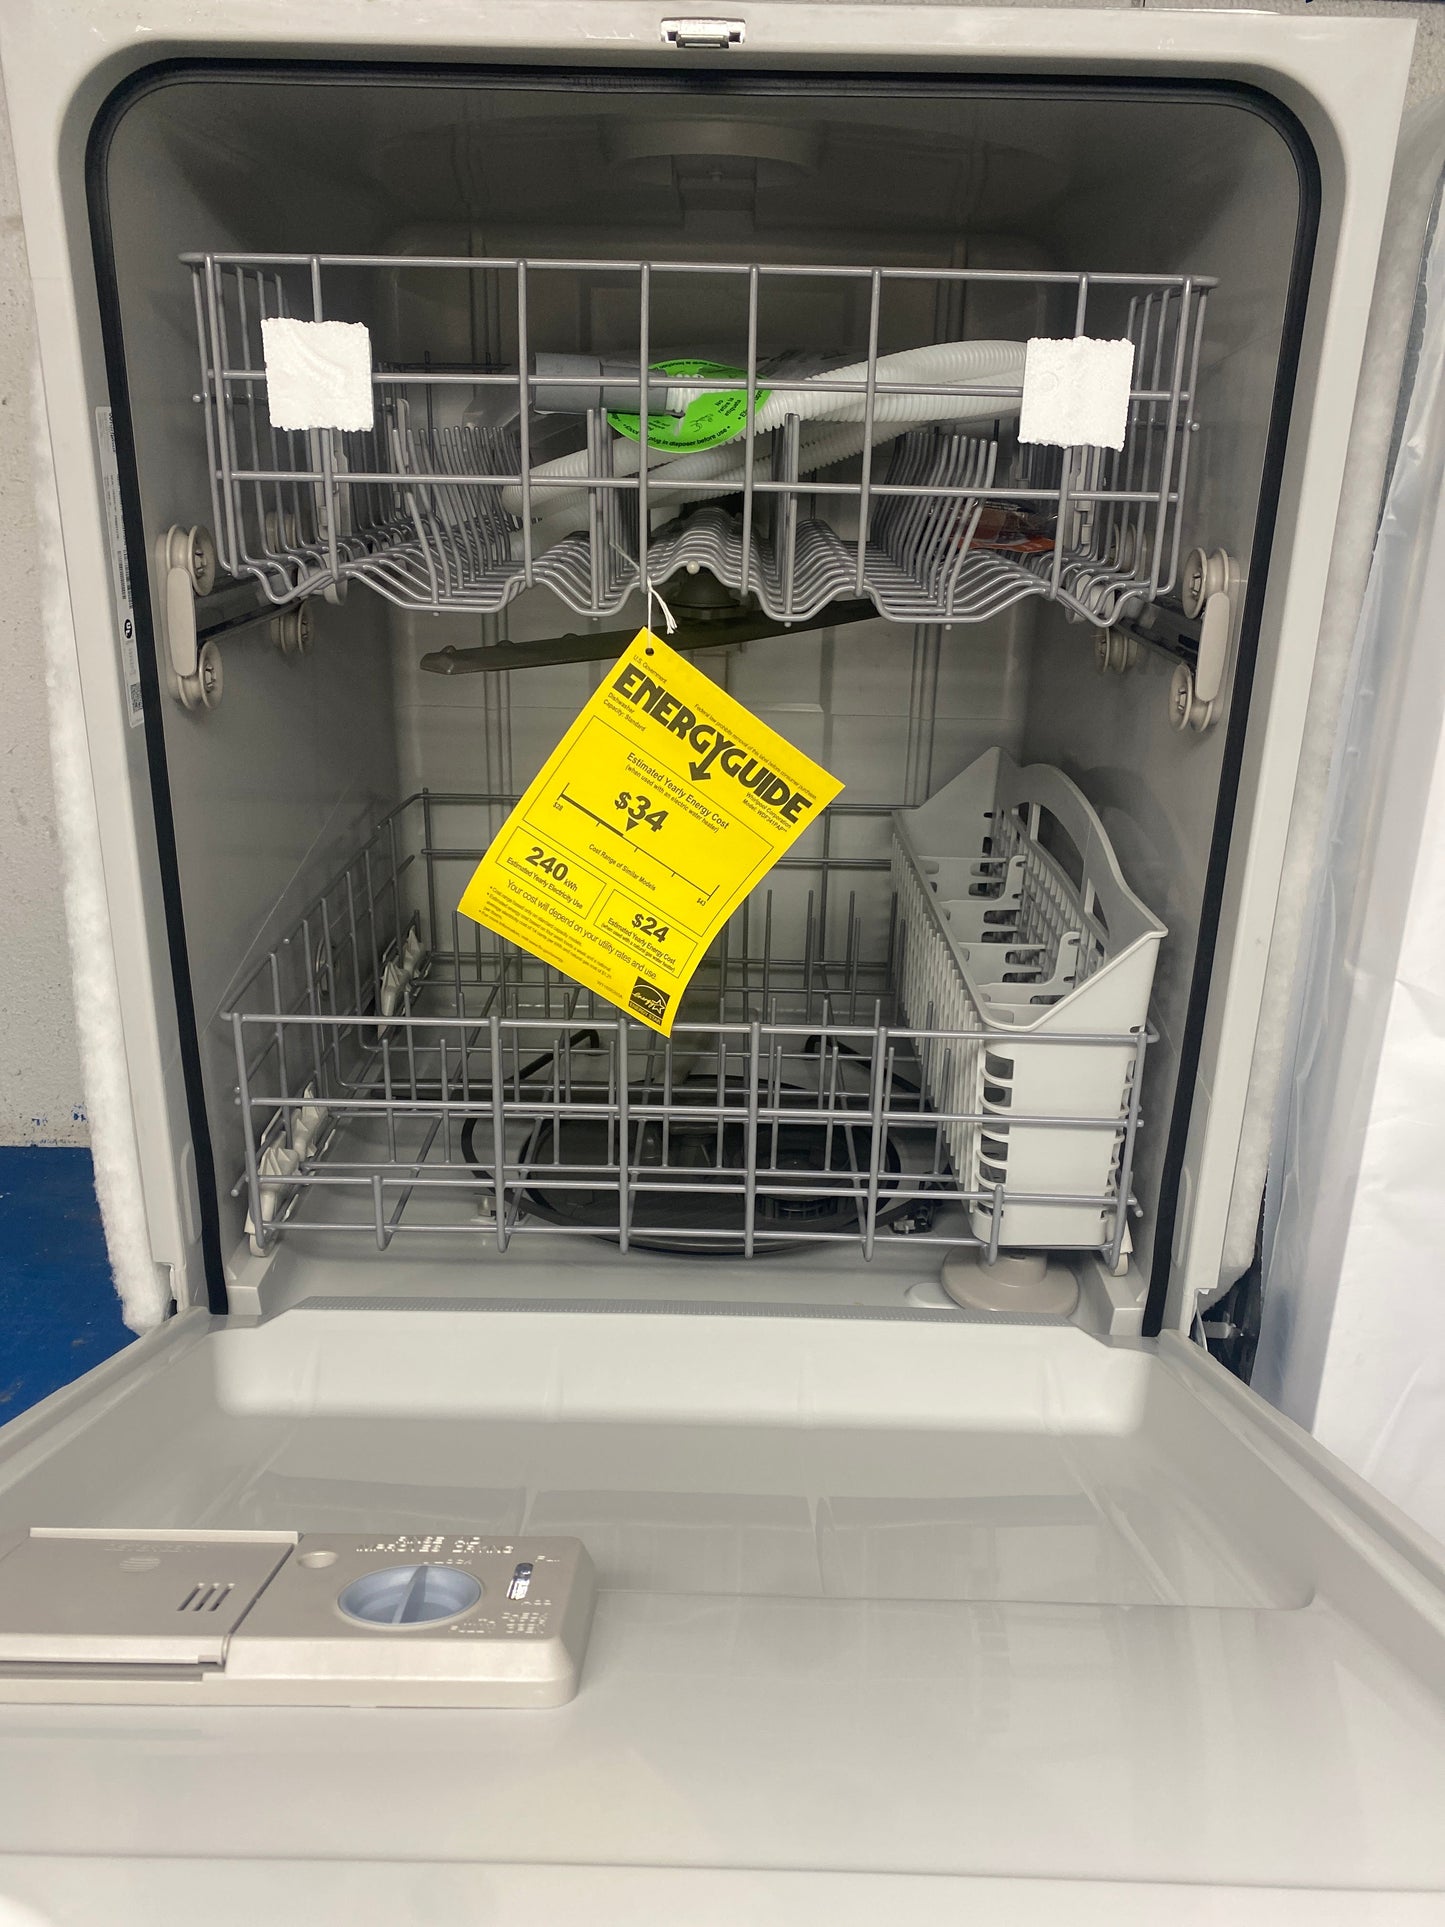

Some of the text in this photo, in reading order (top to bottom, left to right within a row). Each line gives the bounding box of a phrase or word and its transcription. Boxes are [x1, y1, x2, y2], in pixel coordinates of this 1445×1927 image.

[669, 440, 696, 449] disposer
[697, 434, 717, 445] before
[717, 428, 728, 438] use
[632, 654, 668, 684] U.S. Government
[603, 698, 646, 732] Capacity: Standard
[607, 691, 635, 714] Dishwasher
[611, 662, 813, 824] ENERGYGUIDE
[552, 801, 564, 811] $28
[624, 763, 720, 834] (when used with an electric water heater)
[626, 751, 730, 829] Estimated Yearly Energy Cost
[742, 798, 757, 811] Model:
[614, 791, 669, 832] $34
[745, 791, 792, 829] Whirlpool Corporation
[506, 856, 583, 909] Estimated Yearly Electricity Use
[524, 846, 578, 892] 240 kWh
[588, 843, 602, 855] Cost
[599, 850, 616, 865] Range
[621, 865, 640, 880] Similar
[638, 875, 656, 891] Models
[696, 897, 706, 907] $43
[507, 878, 657, 981] Your cost will depend on your utility rates and use.
[607, 917, 676, 965] Estimated Yearly Energy Cost
[631, 913, 669, 943] $24
